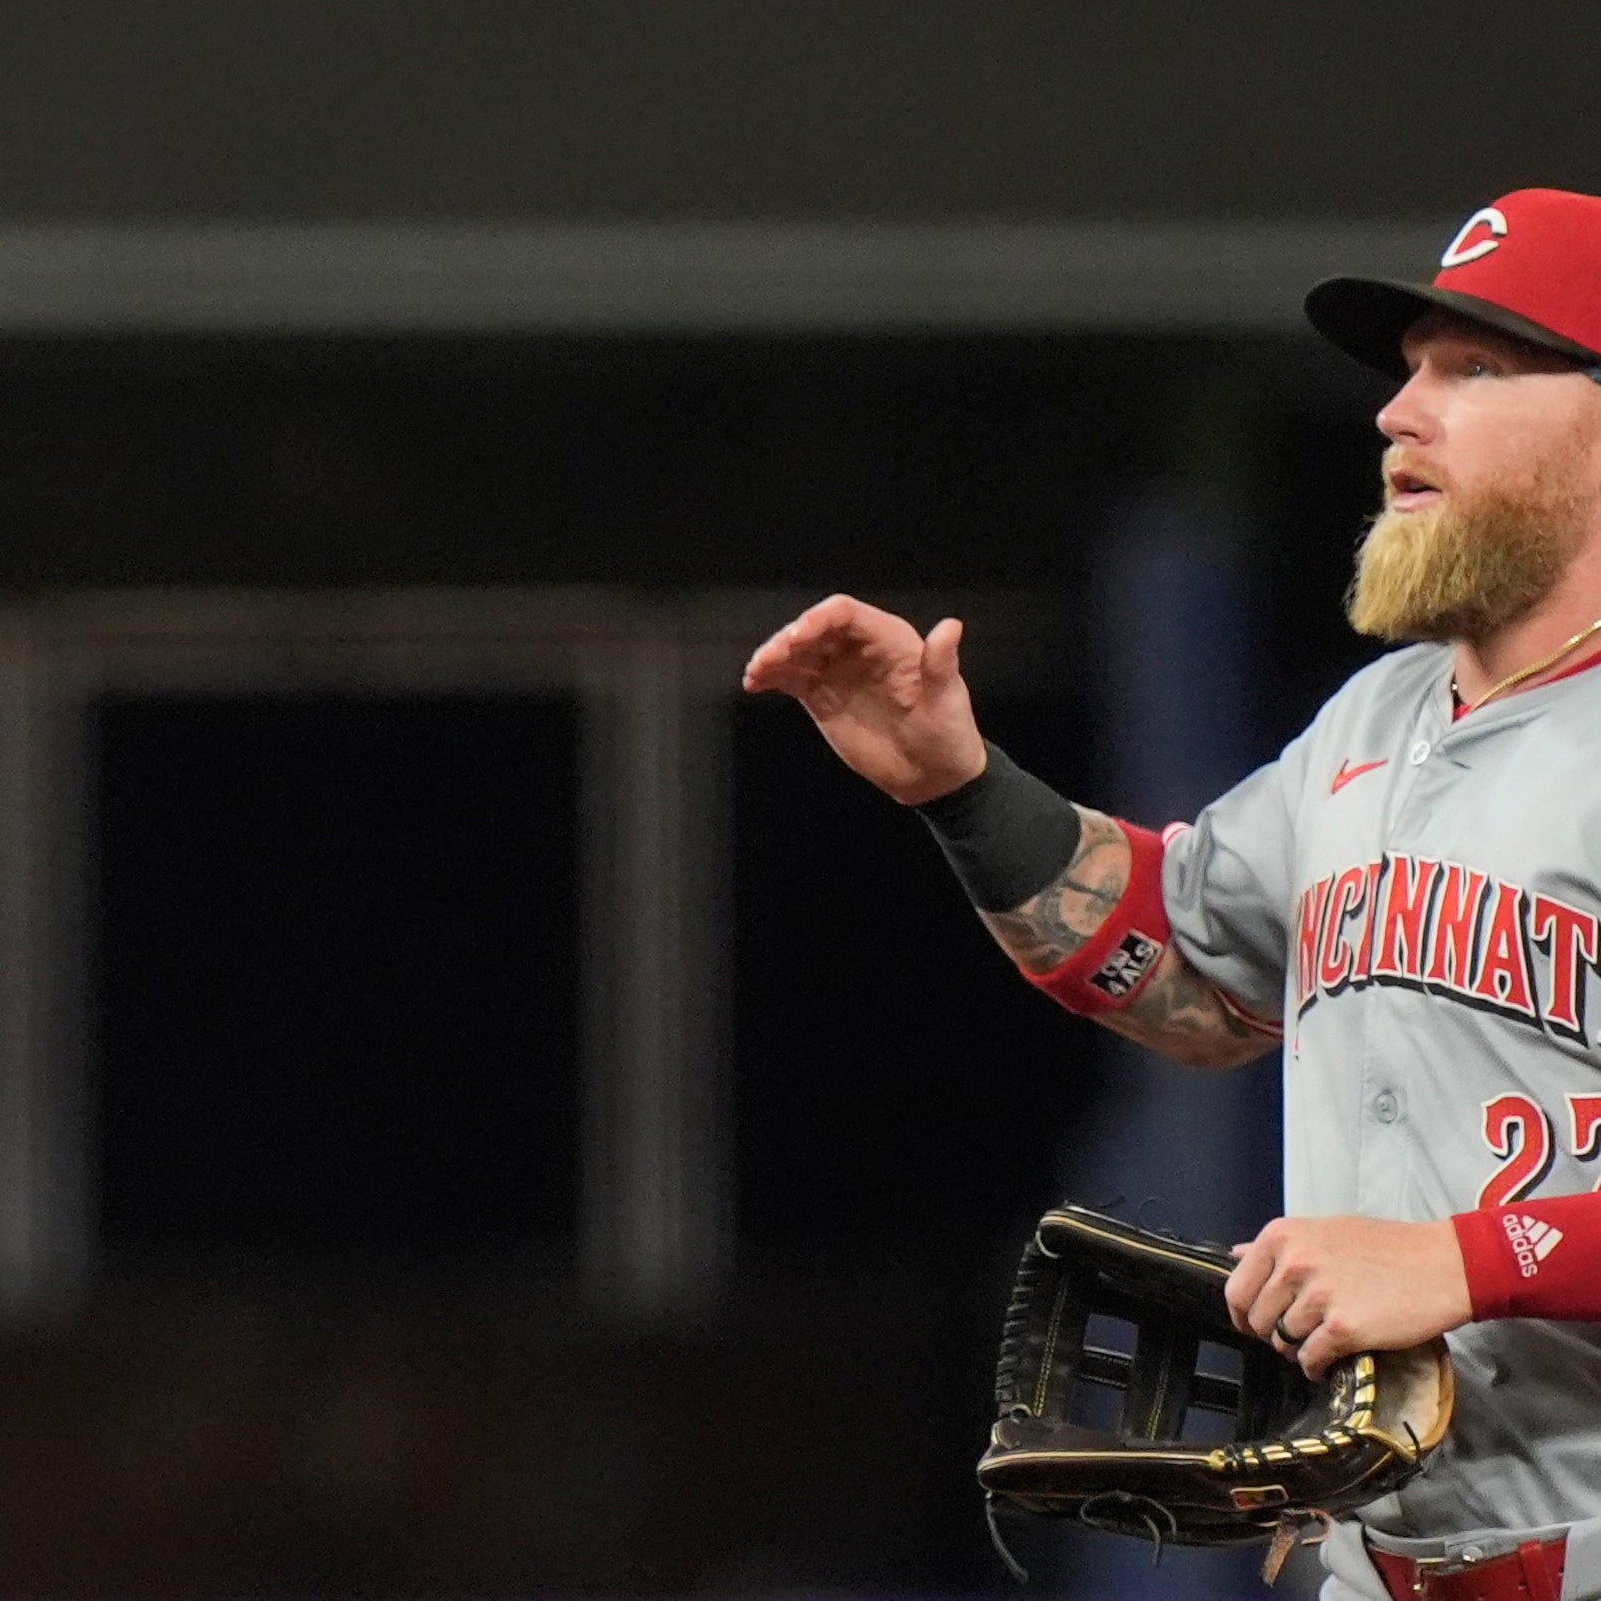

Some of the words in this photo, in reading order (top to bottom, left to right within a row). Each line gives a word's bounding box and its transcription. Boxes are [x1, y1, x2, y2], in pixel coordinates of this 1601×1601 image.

[1441, 207, 1508, 269] C
[1295, 850, 1601, 1051] NCINNAT
[1502, 1213, 1539, 1278] adidas
